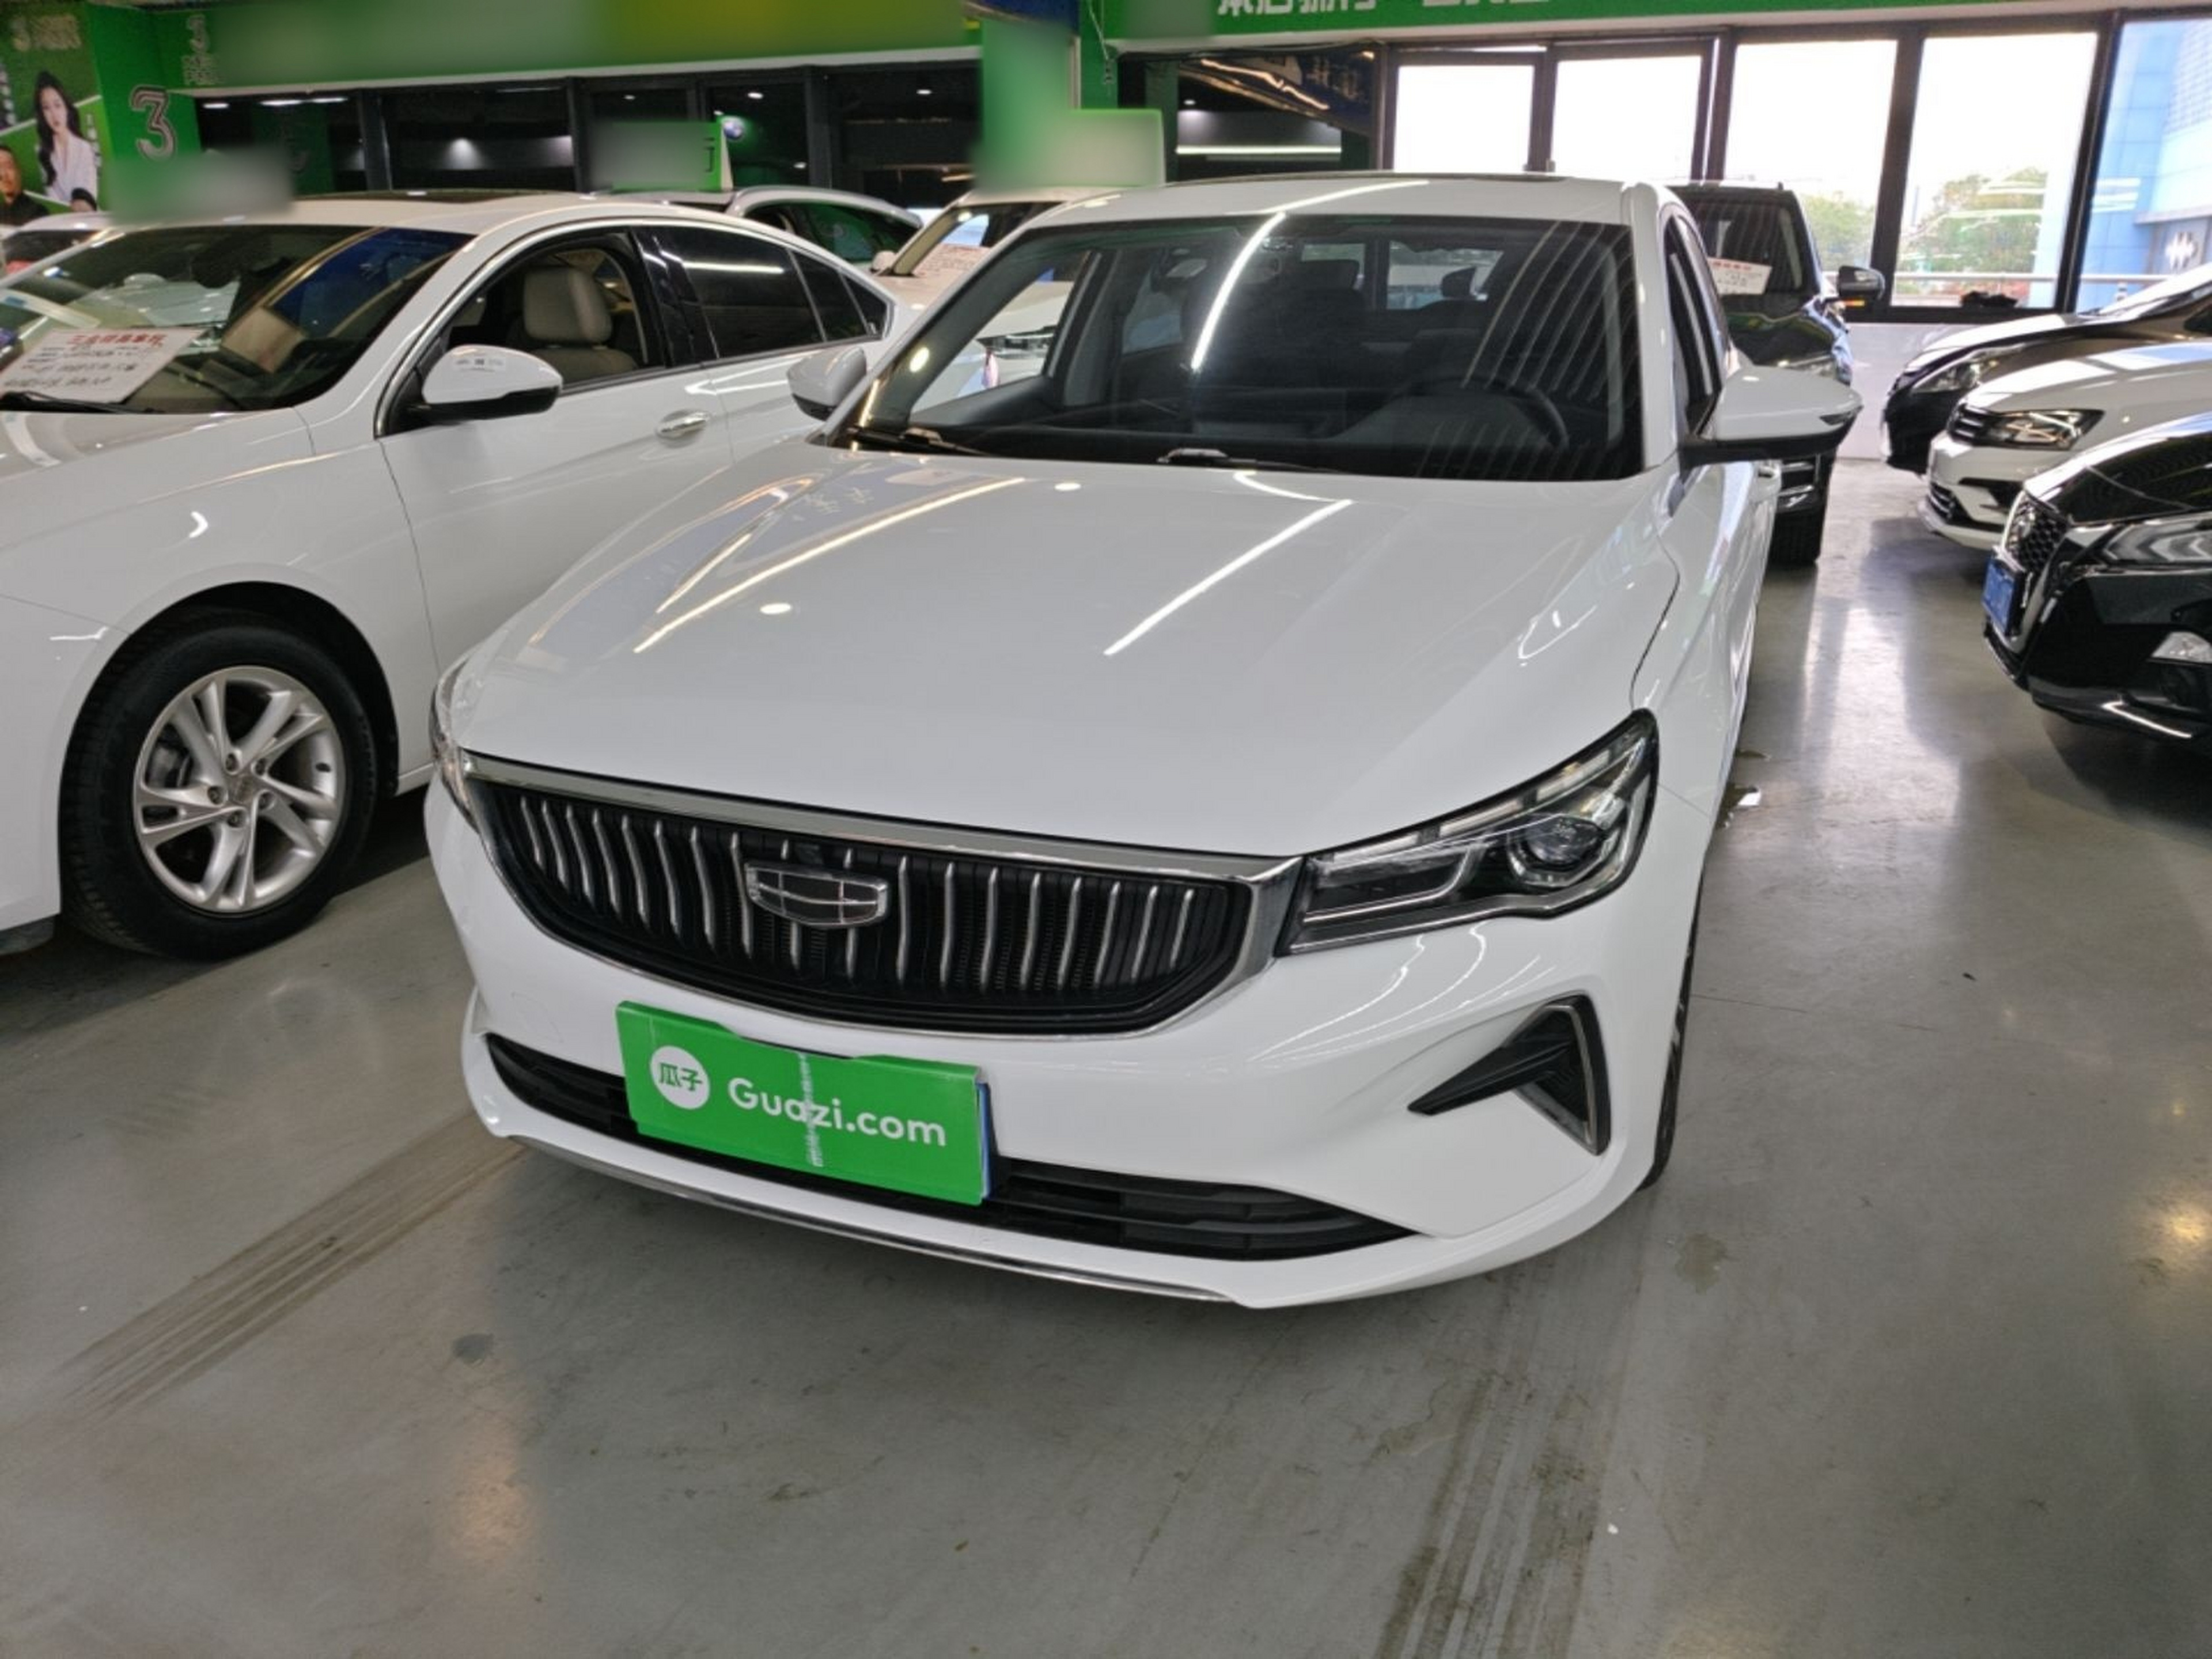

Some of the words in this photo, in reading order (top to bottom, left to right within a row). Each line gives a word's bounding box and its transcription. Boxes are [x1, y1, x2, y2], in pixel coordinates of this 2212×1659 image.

[130, 85, 177, 161] 3
[658, 1062, 703, 1092] 瓜子
[728, 1077, 946, 1147] Guazi.com
